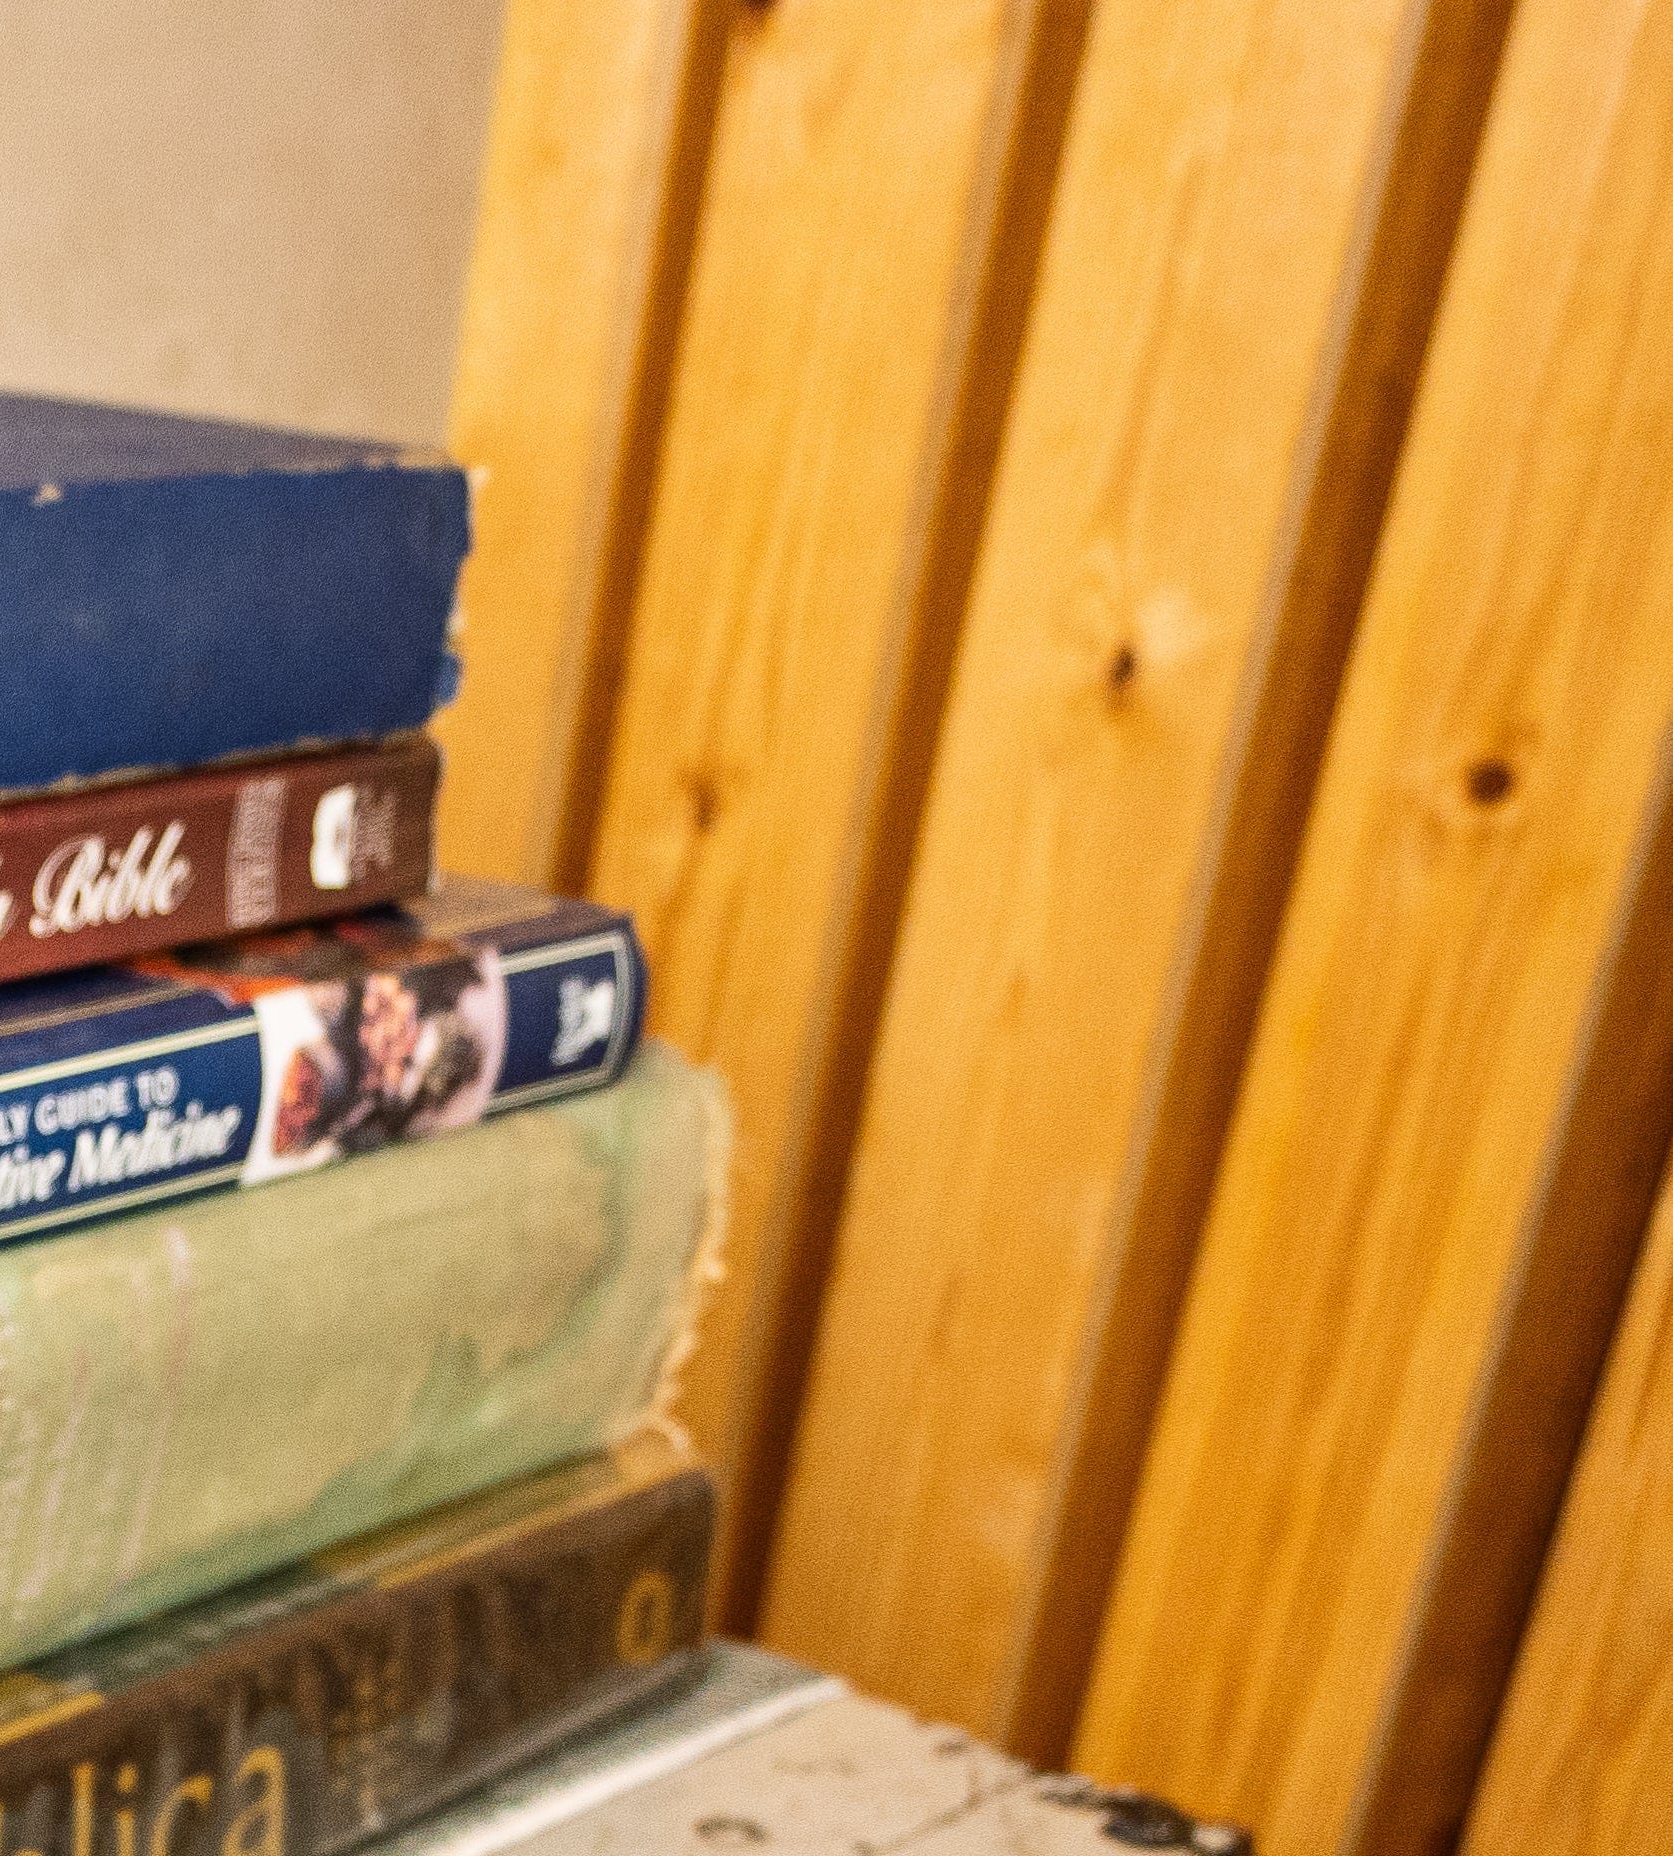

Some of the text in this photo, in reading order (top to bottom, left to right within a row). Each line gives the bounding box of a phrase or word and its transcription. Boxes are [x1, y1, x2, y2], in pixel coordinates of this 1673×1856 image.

[29, 818, 194, 939] Bible
[35, 1076, 130, 1137] GUIDE
[134, 1065, 180, 1108] TO
[67, 1101, 243, 1192] Medicine
